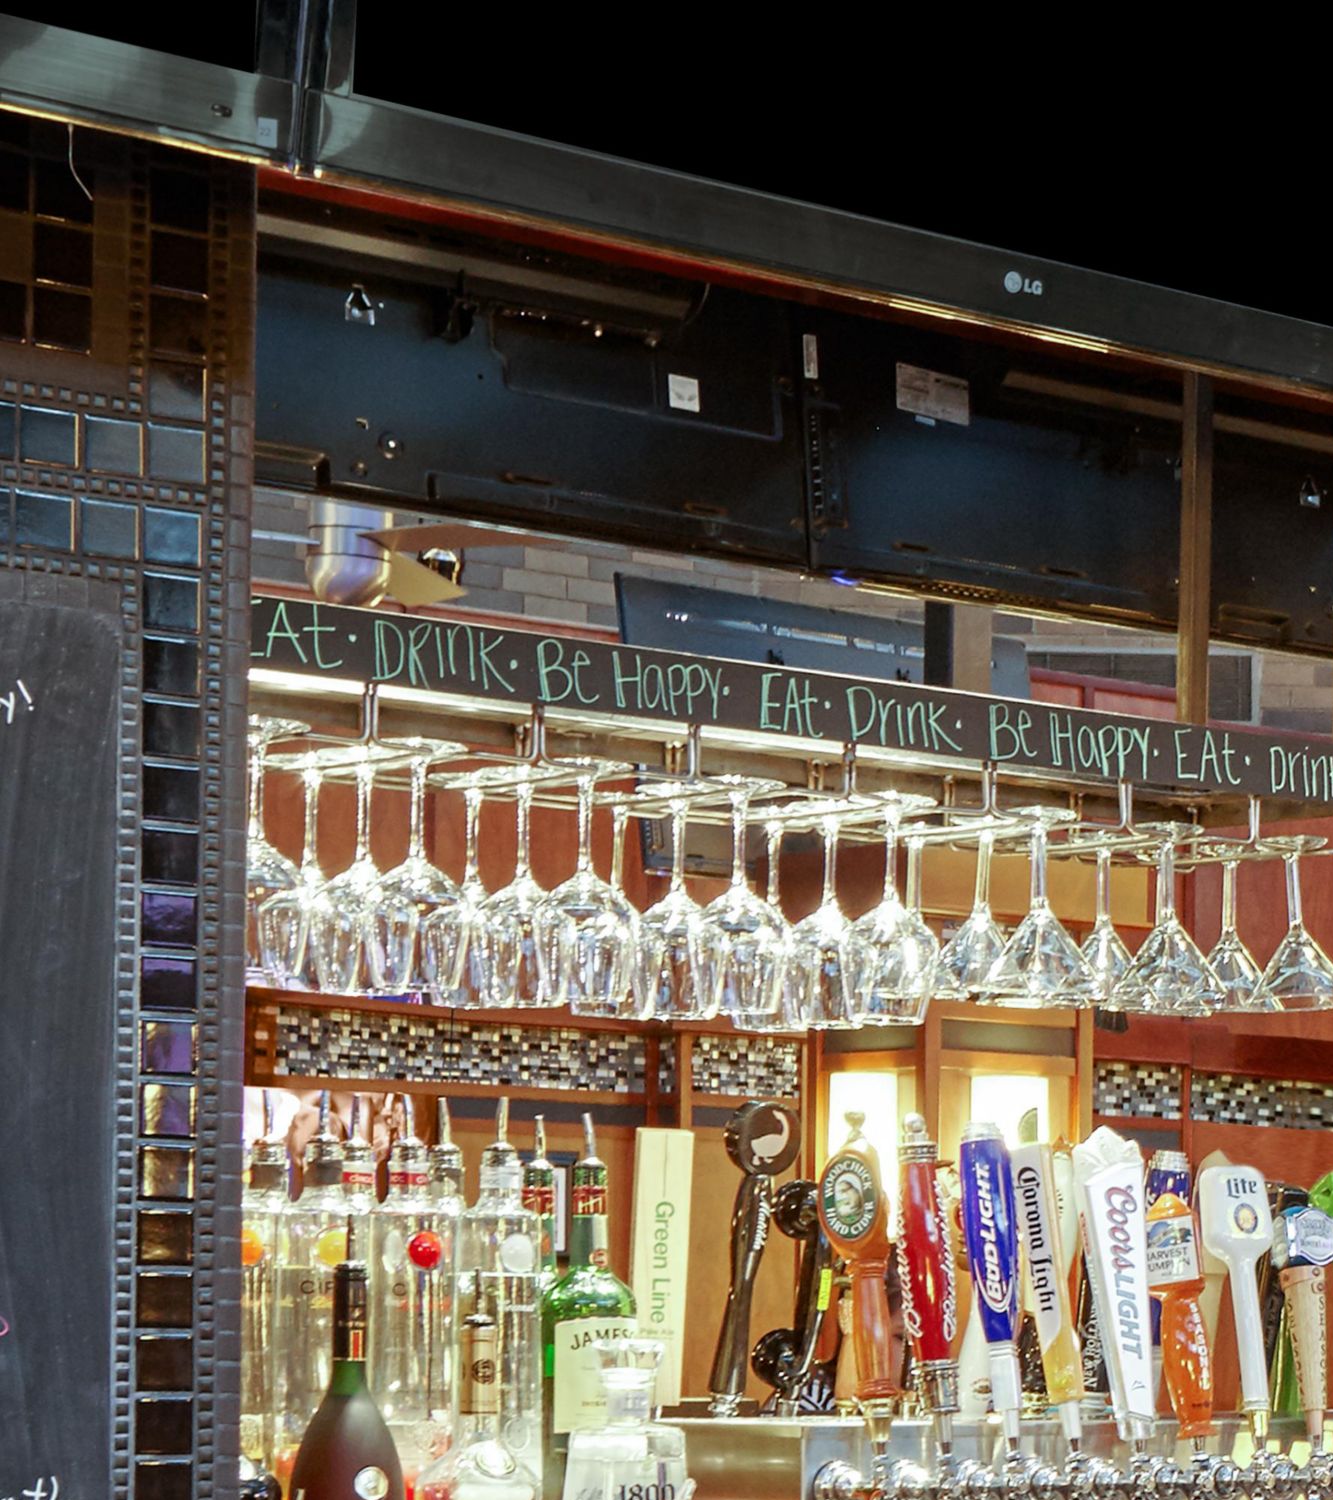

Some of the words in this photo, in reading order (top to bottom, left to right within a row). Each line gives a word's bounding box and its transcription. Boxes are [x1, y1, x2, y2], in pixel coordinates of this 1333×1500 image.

[1022, 278, 1043, 296] LG
[250, 598, 344, 670] At
[536, 638, 600, 704] Be
[988, 702, 1038, 761] Be
[975, 1162, 996, 1246] LIGHT
[1015, 1166, 1046, 1250] Corona
[1226, 1177, 1258, 1199] Lite
[655, 1200, 676, 1270] Green
[1104, 1184, 1138, 1271] Coors
[650, 1277, 671, 1325] Line
[985, 1246, 1005, 1301] BUD
[1113, 1271, 1143, 1361] LIGHT
